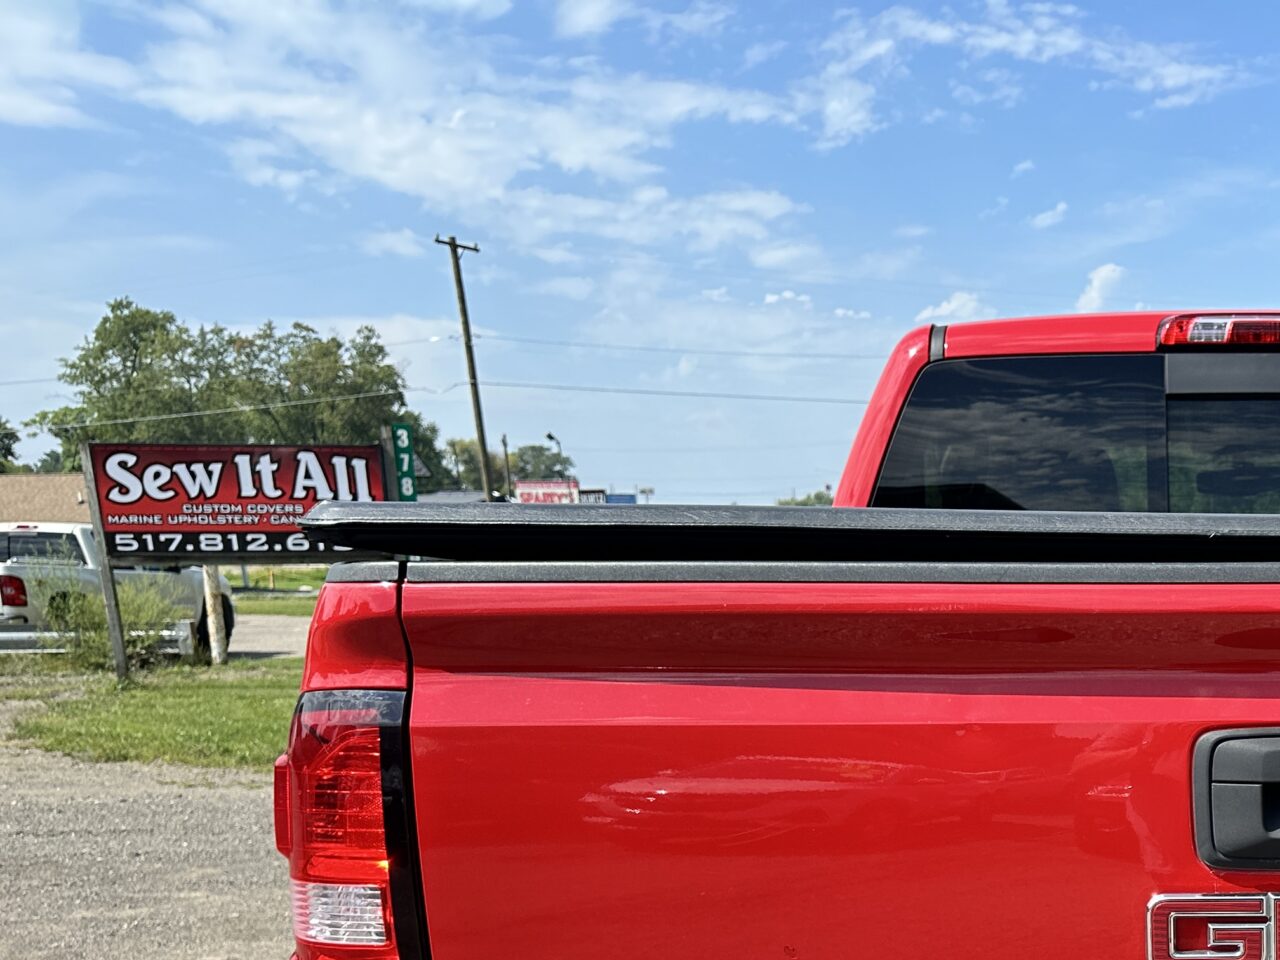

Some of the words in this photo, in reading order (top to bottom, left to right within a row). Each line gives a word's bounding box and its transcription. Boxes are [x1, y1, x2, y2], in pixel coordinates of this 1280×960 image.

[105, 452, 224, 503] Sew
[234, 453, 283, 499] It
[293, 450, 374, 502] All
[182, 503, 243, 514] CUSTOM
[246, 503, 304, 514] COVERS
[107, 514, 163, 525] MARINE
[167, 514, 260, 525] UPHOLSTERY
[270, 514, 305, 525] CAN
[114, 533, 354, 552] 517.812.6
